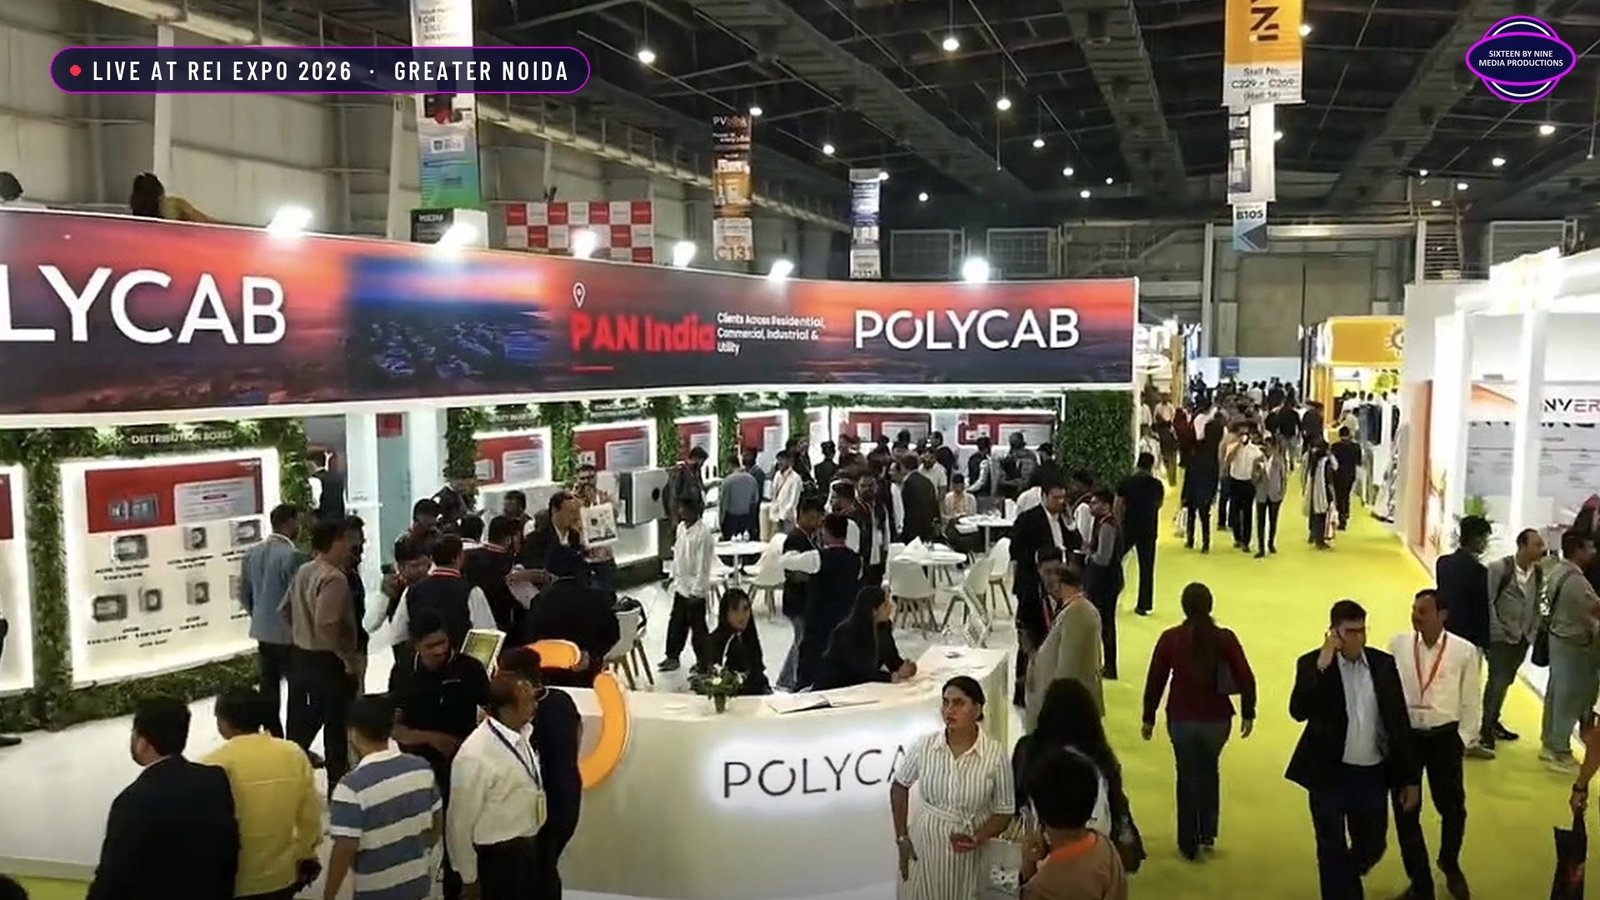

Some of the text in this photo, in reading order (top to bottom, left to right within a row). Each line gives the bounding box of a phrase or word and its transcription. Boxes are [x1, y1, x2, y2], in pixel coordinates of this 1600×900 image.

[0, 265, 287, 345] LYCAB
[717, 312, 744, 324] Clients
[745, 315, 771, 325] Across
[570, 311, 716, 353] PAN India
[717, 327, 819, 340] Commercial, Industrial &
[854, 308, 1081, 350] POLYCAB
[717, 341, 741, 356] Utility
